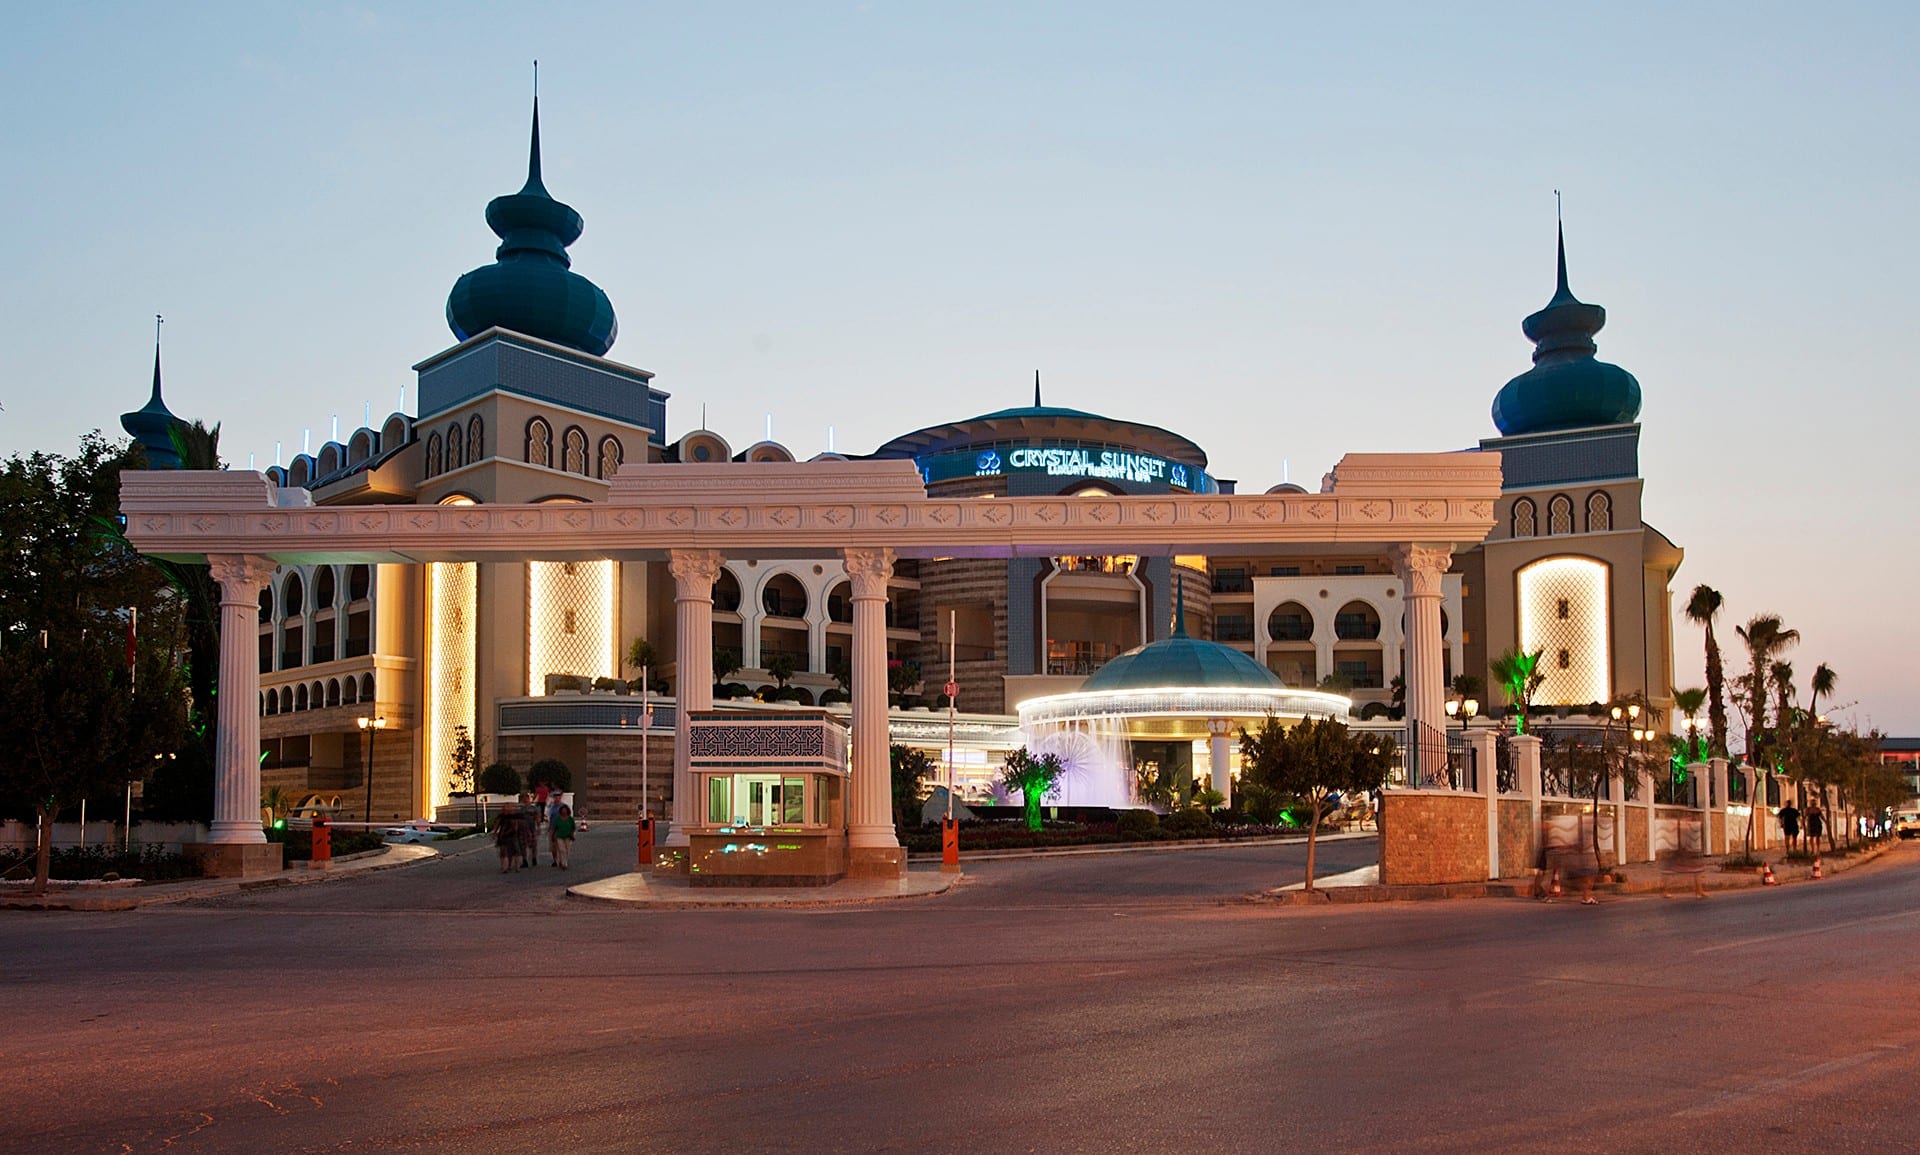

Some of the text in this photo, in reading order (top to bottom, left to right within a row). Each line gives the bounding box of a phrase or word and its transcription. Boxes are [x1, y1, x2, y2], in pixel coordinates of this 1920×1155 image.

[1010, 449, 1166, 477] CRYSTAL SUNSET
[1047, 464, 1087, 475] LUXURY
[1088, 465, 1125, 479] RESORT
